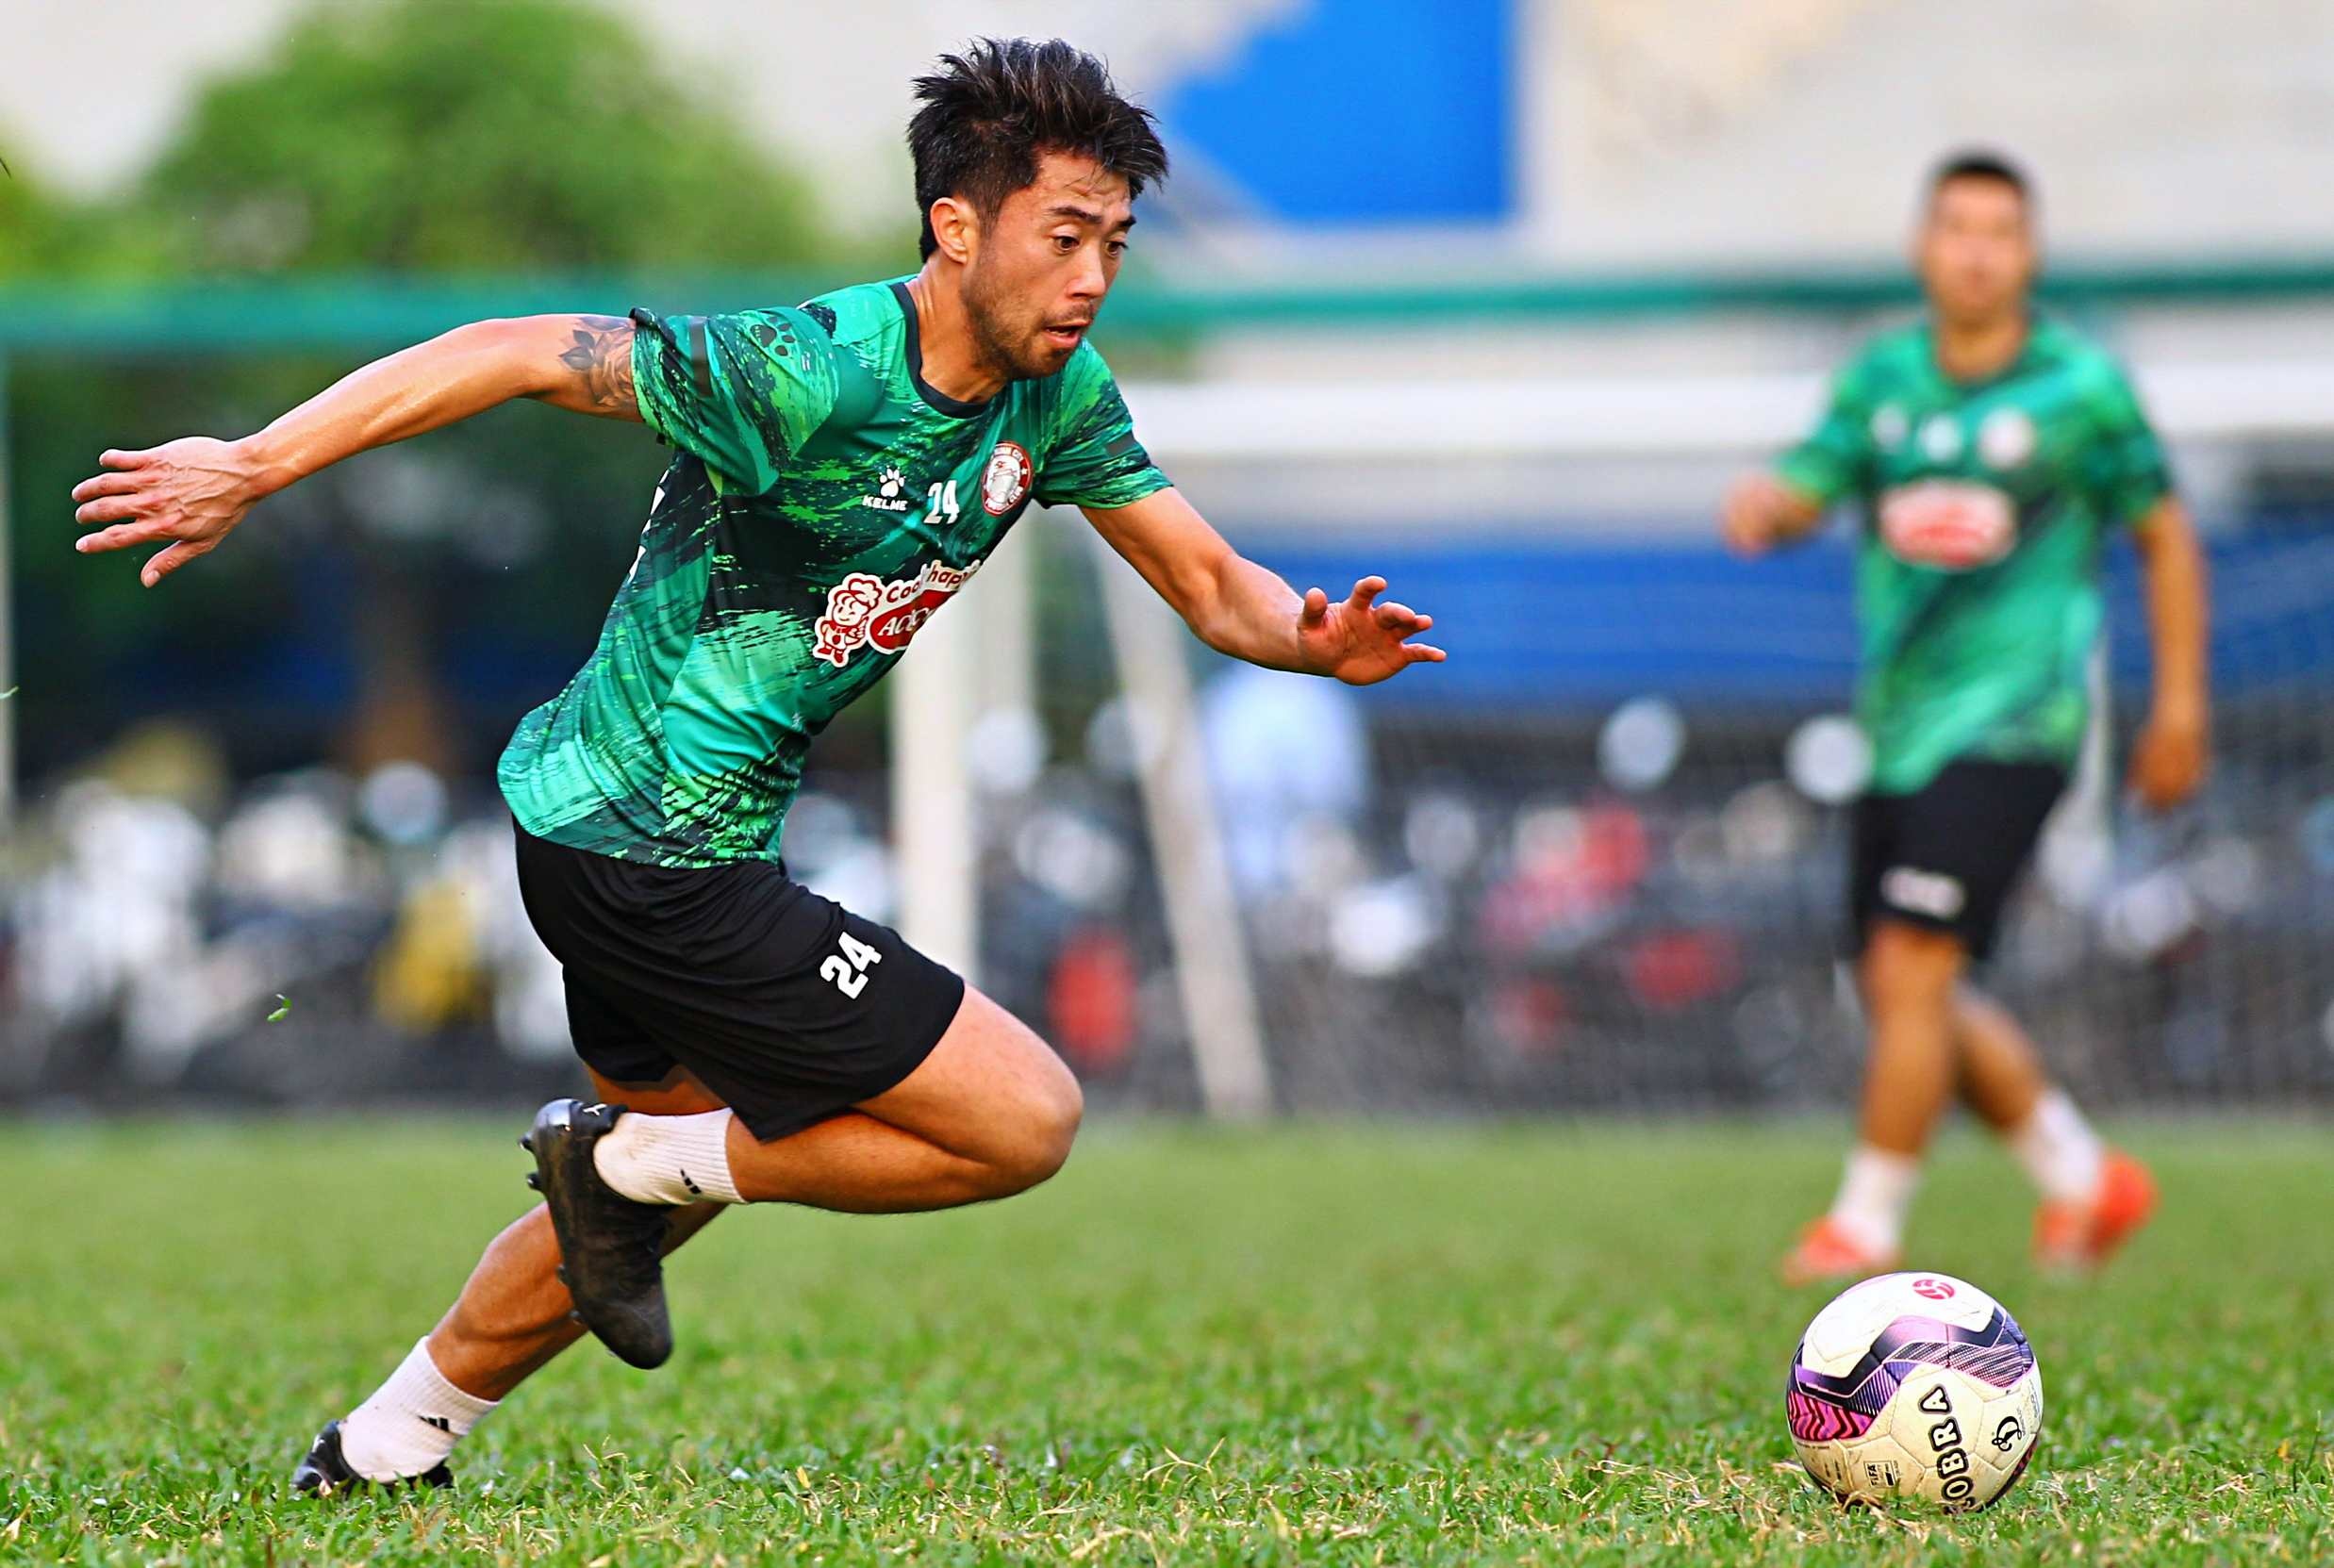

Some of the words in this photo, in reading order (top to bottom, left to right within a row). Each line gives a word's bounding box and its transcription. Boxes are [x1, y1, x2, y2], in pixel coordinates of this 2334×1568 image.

[862, 495, 908, 511] KELME
[923, 479, 960, 524] 24
[886, 581, 921, 603] Coo
[819, 931, 883, 1000] 24
[1867, 1462, 1879, 1487] FIFA
